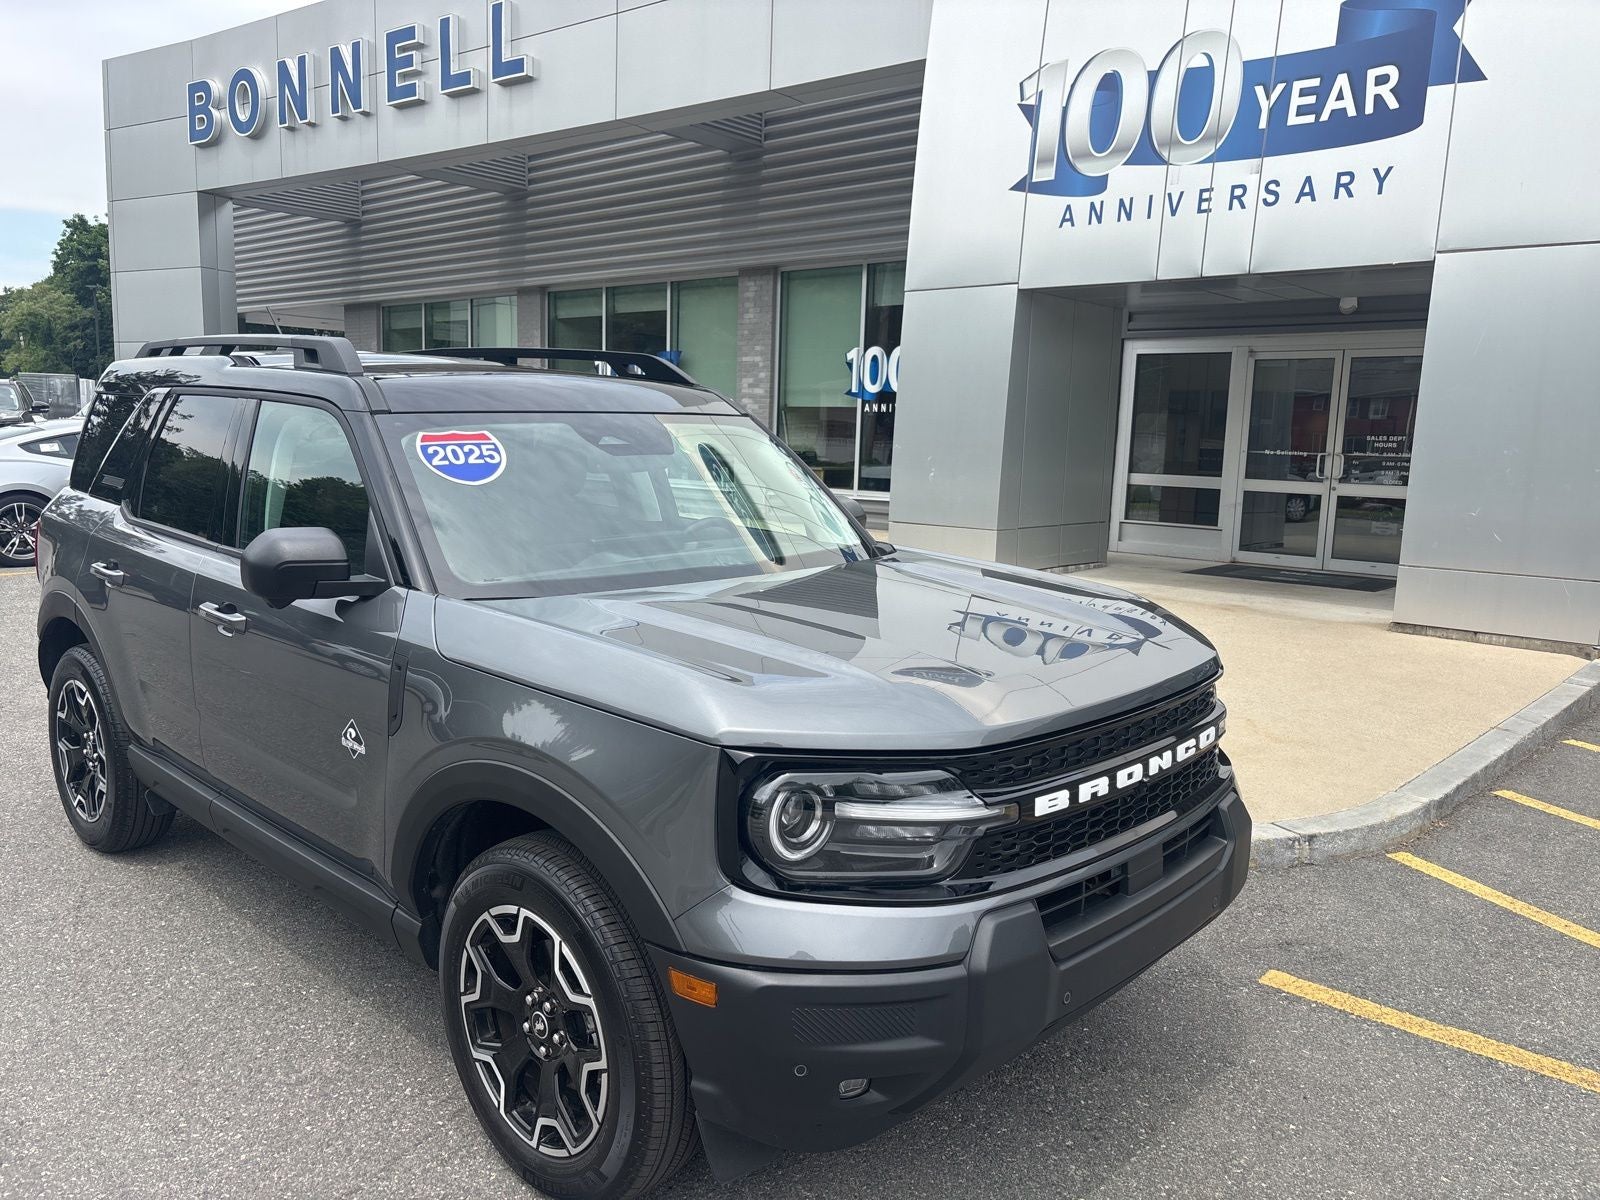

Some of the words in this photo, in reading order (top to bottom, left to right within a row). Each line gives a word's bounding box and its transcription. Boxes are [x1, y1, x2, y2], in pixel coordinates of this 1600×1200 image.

[186, 0, 533, 145] BONNELL
[1019, 28, 1243, 182] 100
[1253, 64, 1400, 130] YEAR
[1058, 165, 1395, 228] ANNIVERSARY
[863, 403, 897, 413] ANNI
[427, 444, 501, 466] 2025
[1034, 726, 1216, 817] BRONCO
